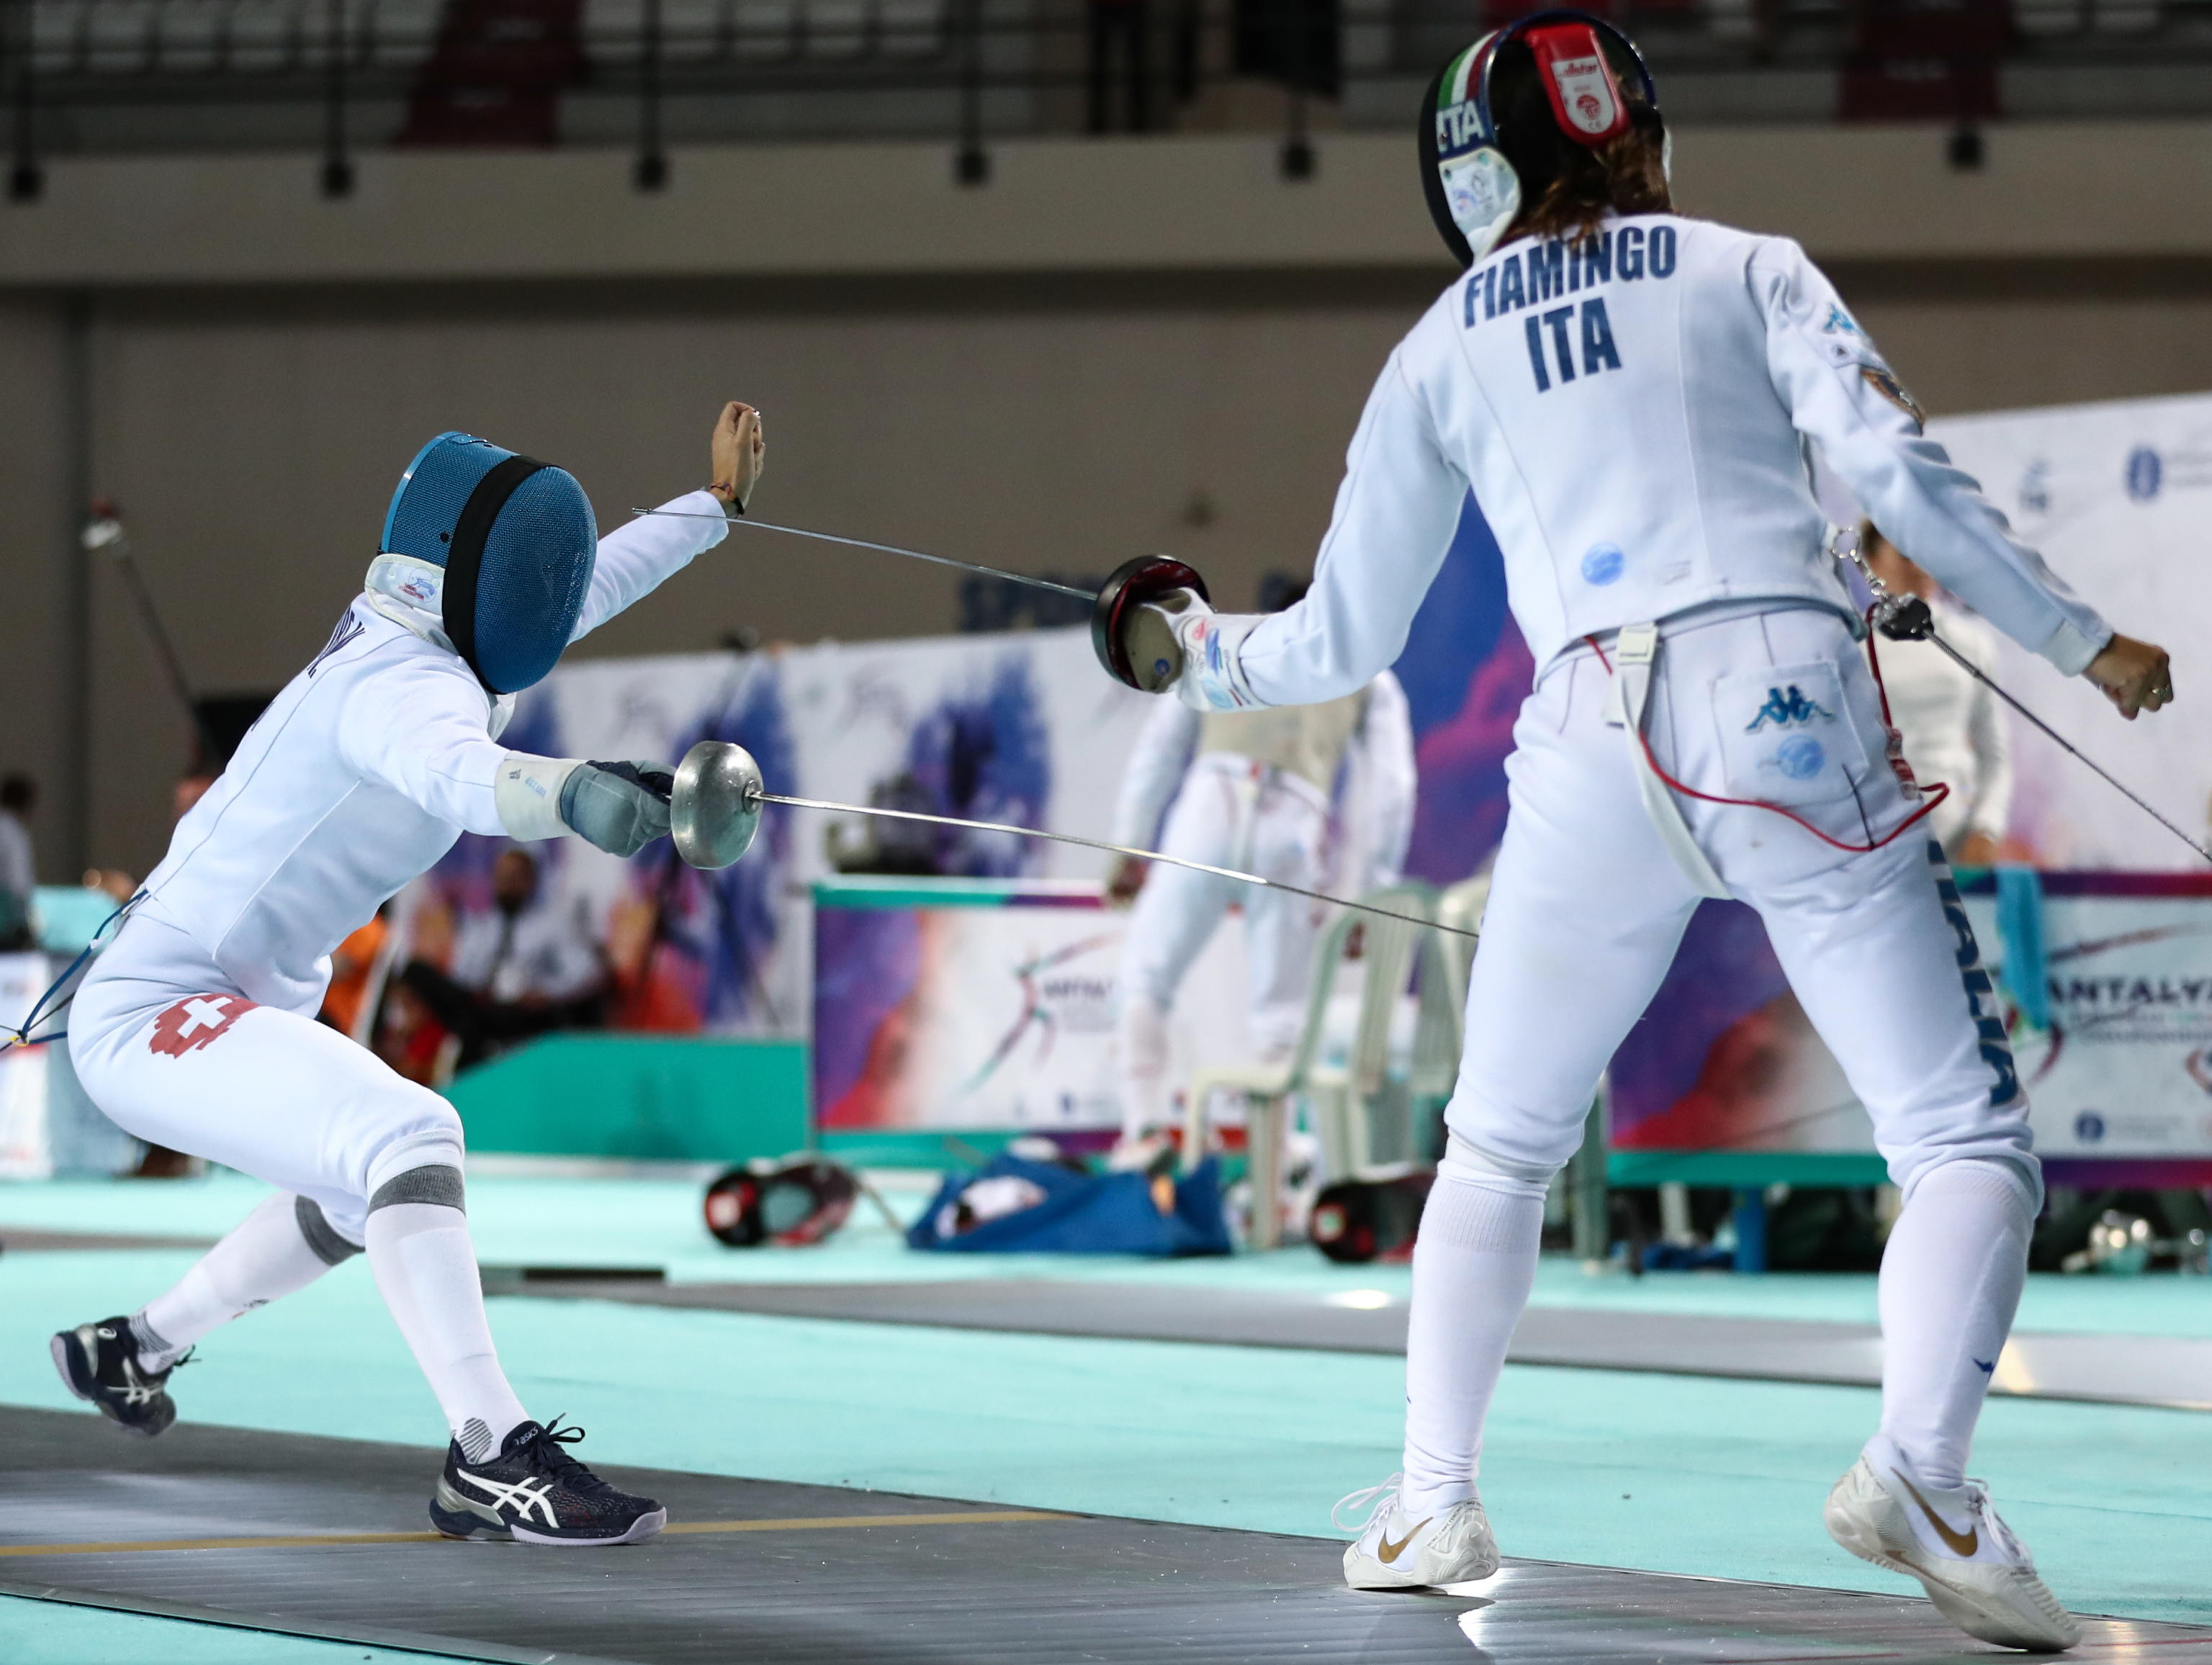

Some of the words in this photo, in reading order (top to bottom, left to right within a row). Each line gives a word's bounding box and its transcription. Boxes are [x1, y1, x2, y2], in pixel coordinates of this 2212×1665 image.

[1436, 101, 1485, 153] ITA
[1464, 226, 1676, 329] FIAMINGO
[1524, 297, 1622, 393] ITA
[2046, 977, 2212, 1003] ANTALY
